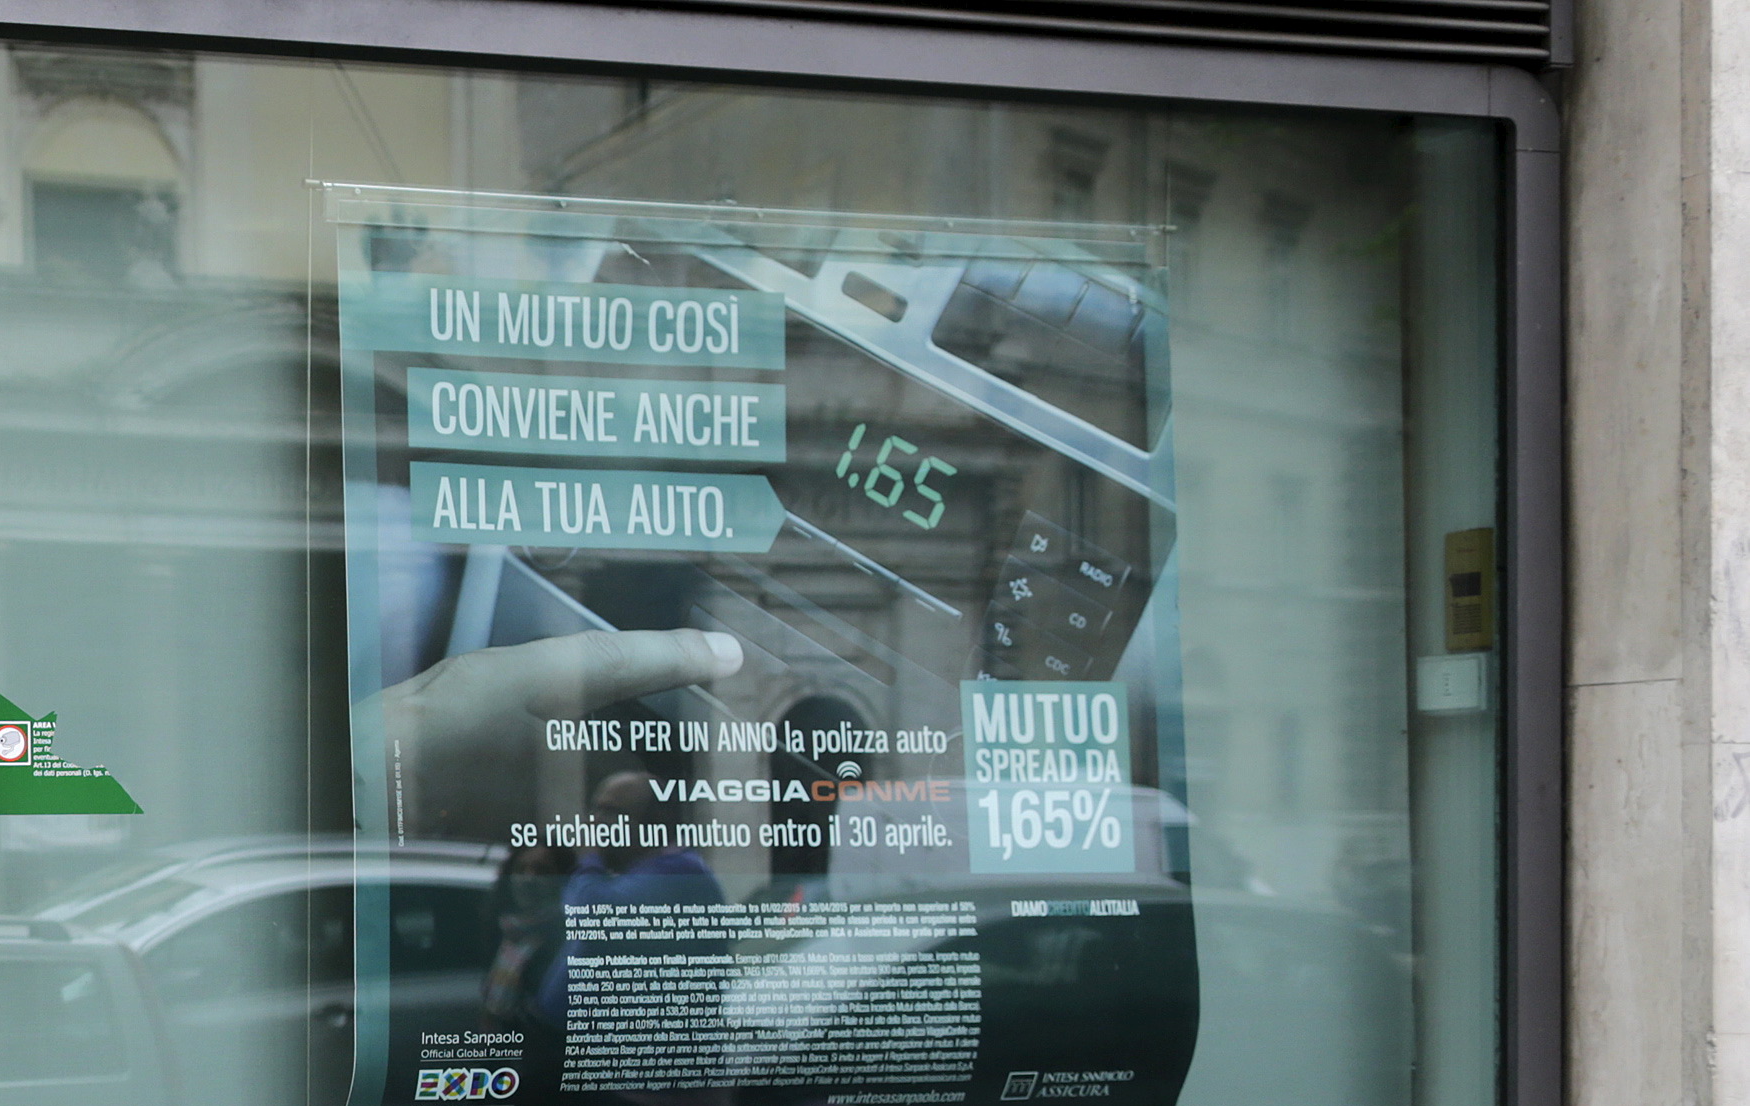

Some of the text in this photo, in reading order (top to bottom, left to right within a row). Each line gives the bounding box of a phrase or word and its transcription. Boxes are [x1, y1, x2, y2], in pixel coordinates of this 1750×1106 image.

[430, 287, 741, 356] UN MUTUO COSÌ
[432, 381, 761, 448] CONVIENE ANCHE
[836, 422, 958, 531] 1.65
[433, 475, 735, 540] ALLA TUA AUTO.
[1079, 560, 1114, 588] RADIO
[1068, 612, 1087, 629] CD
[1045, 655, 1072, 676] CDC
[972, 693, 1119, 744] MUTUO
[546, 720, 947, 760] GRATIS PER UN ANNO la polizza auto
[976, 748, 1122, 783] SPREAD DA
[649, 779, 951, 802] VIAGGIACONME
[510, 814, 953, 854] se richiedi un mutuo entro il 30 aprile.
[978, 788, 1121, 861] 1,65%
[421, 1030, 524, 1047] Intesa Sanpaolo
[421, 1048, 523, 1059] Official Global Partner
[414, 1067, 520, 1102] EXPO
[827, 1090, 966, 1105] www.intesasanpaolo.com
[1036, 1084, 1110, 1098] ASSICURA
